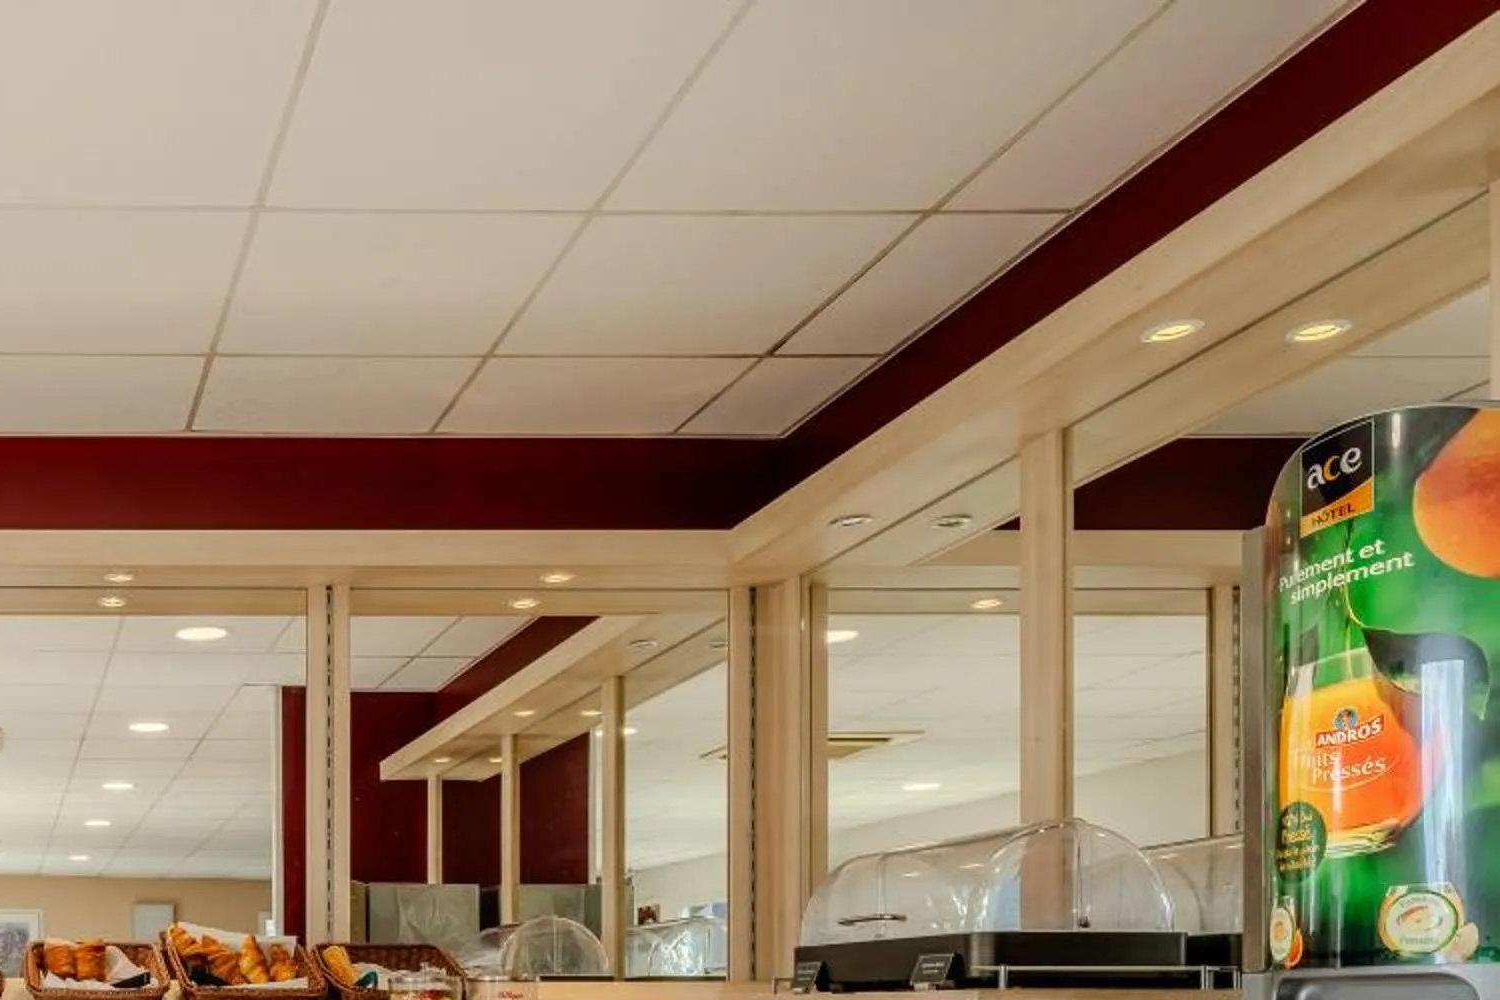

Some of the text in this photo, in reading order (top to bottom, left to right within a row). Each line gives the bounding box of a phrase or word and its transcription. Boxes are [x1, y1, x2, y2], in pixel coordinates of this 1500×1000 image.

[1307, 447, 1362, 490] ace
[1359, 539, 1385, 559] et
[1291, 552, 1414, 605] simplement
[1317, 716, 1381, 746] ANDROS
